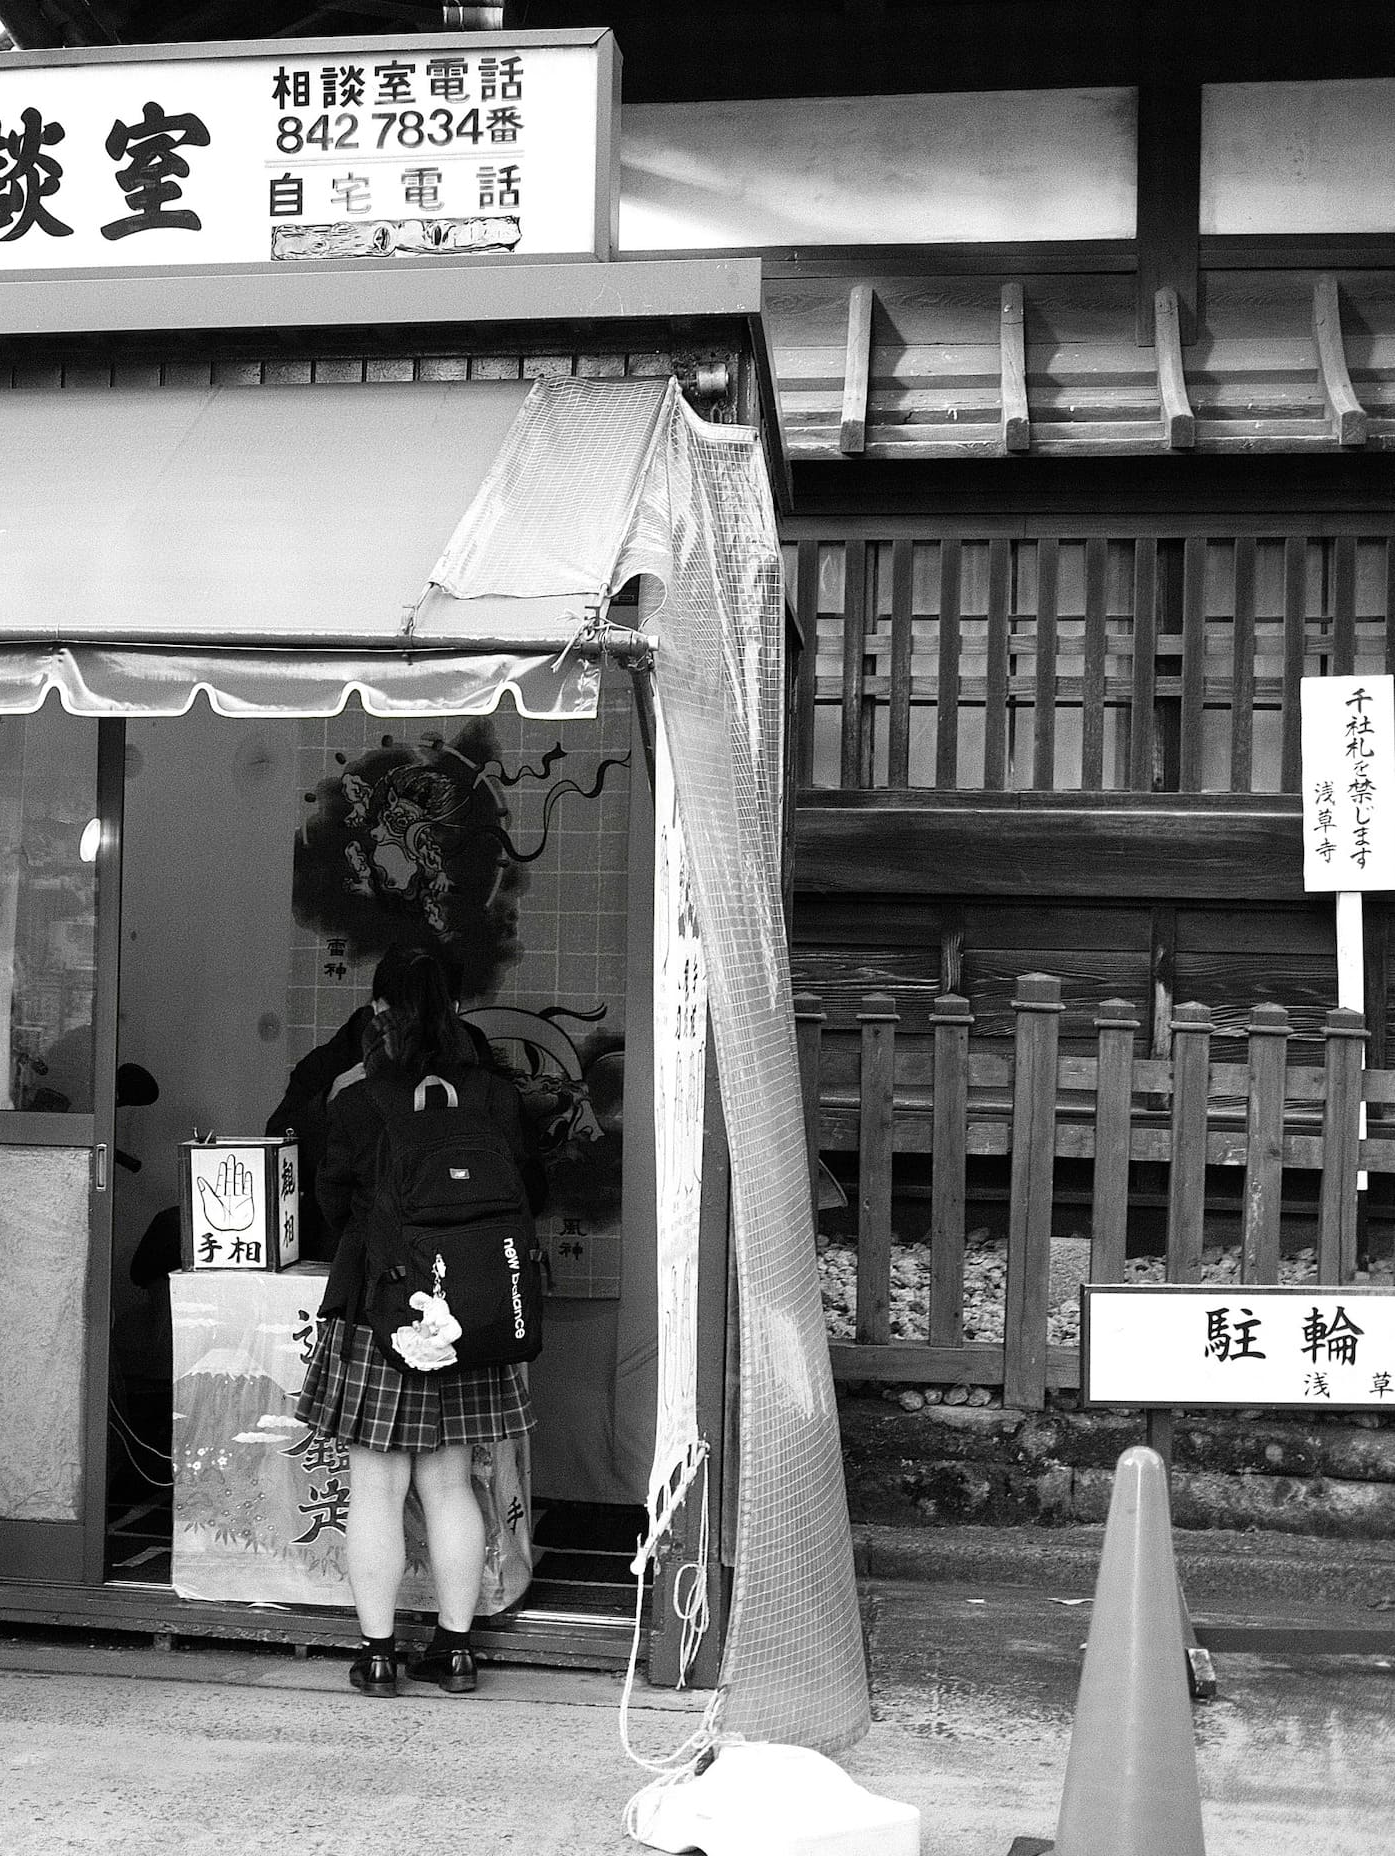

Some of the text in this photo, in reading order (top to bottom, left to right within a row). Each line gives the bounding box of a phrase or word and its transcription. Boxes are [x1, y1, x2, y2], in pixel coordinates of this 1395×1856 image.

[271, 56, 525, 110] 相談室電話
[276, 105, 525, 154] 842 7834番
[269, 164, 522, 217] 自宅電話
[1344, 687, 1378, 870] 千社札を禁じます
[1313, 781, 1338, 864] 浅草寺
[197, 1232, 262, 1264] 手相
[503, 1237, 526, 1339] new balance
[1204, 1306, 1365, 1366] 駐輪
[1304, 1371, 1395, 1399] 浅草
